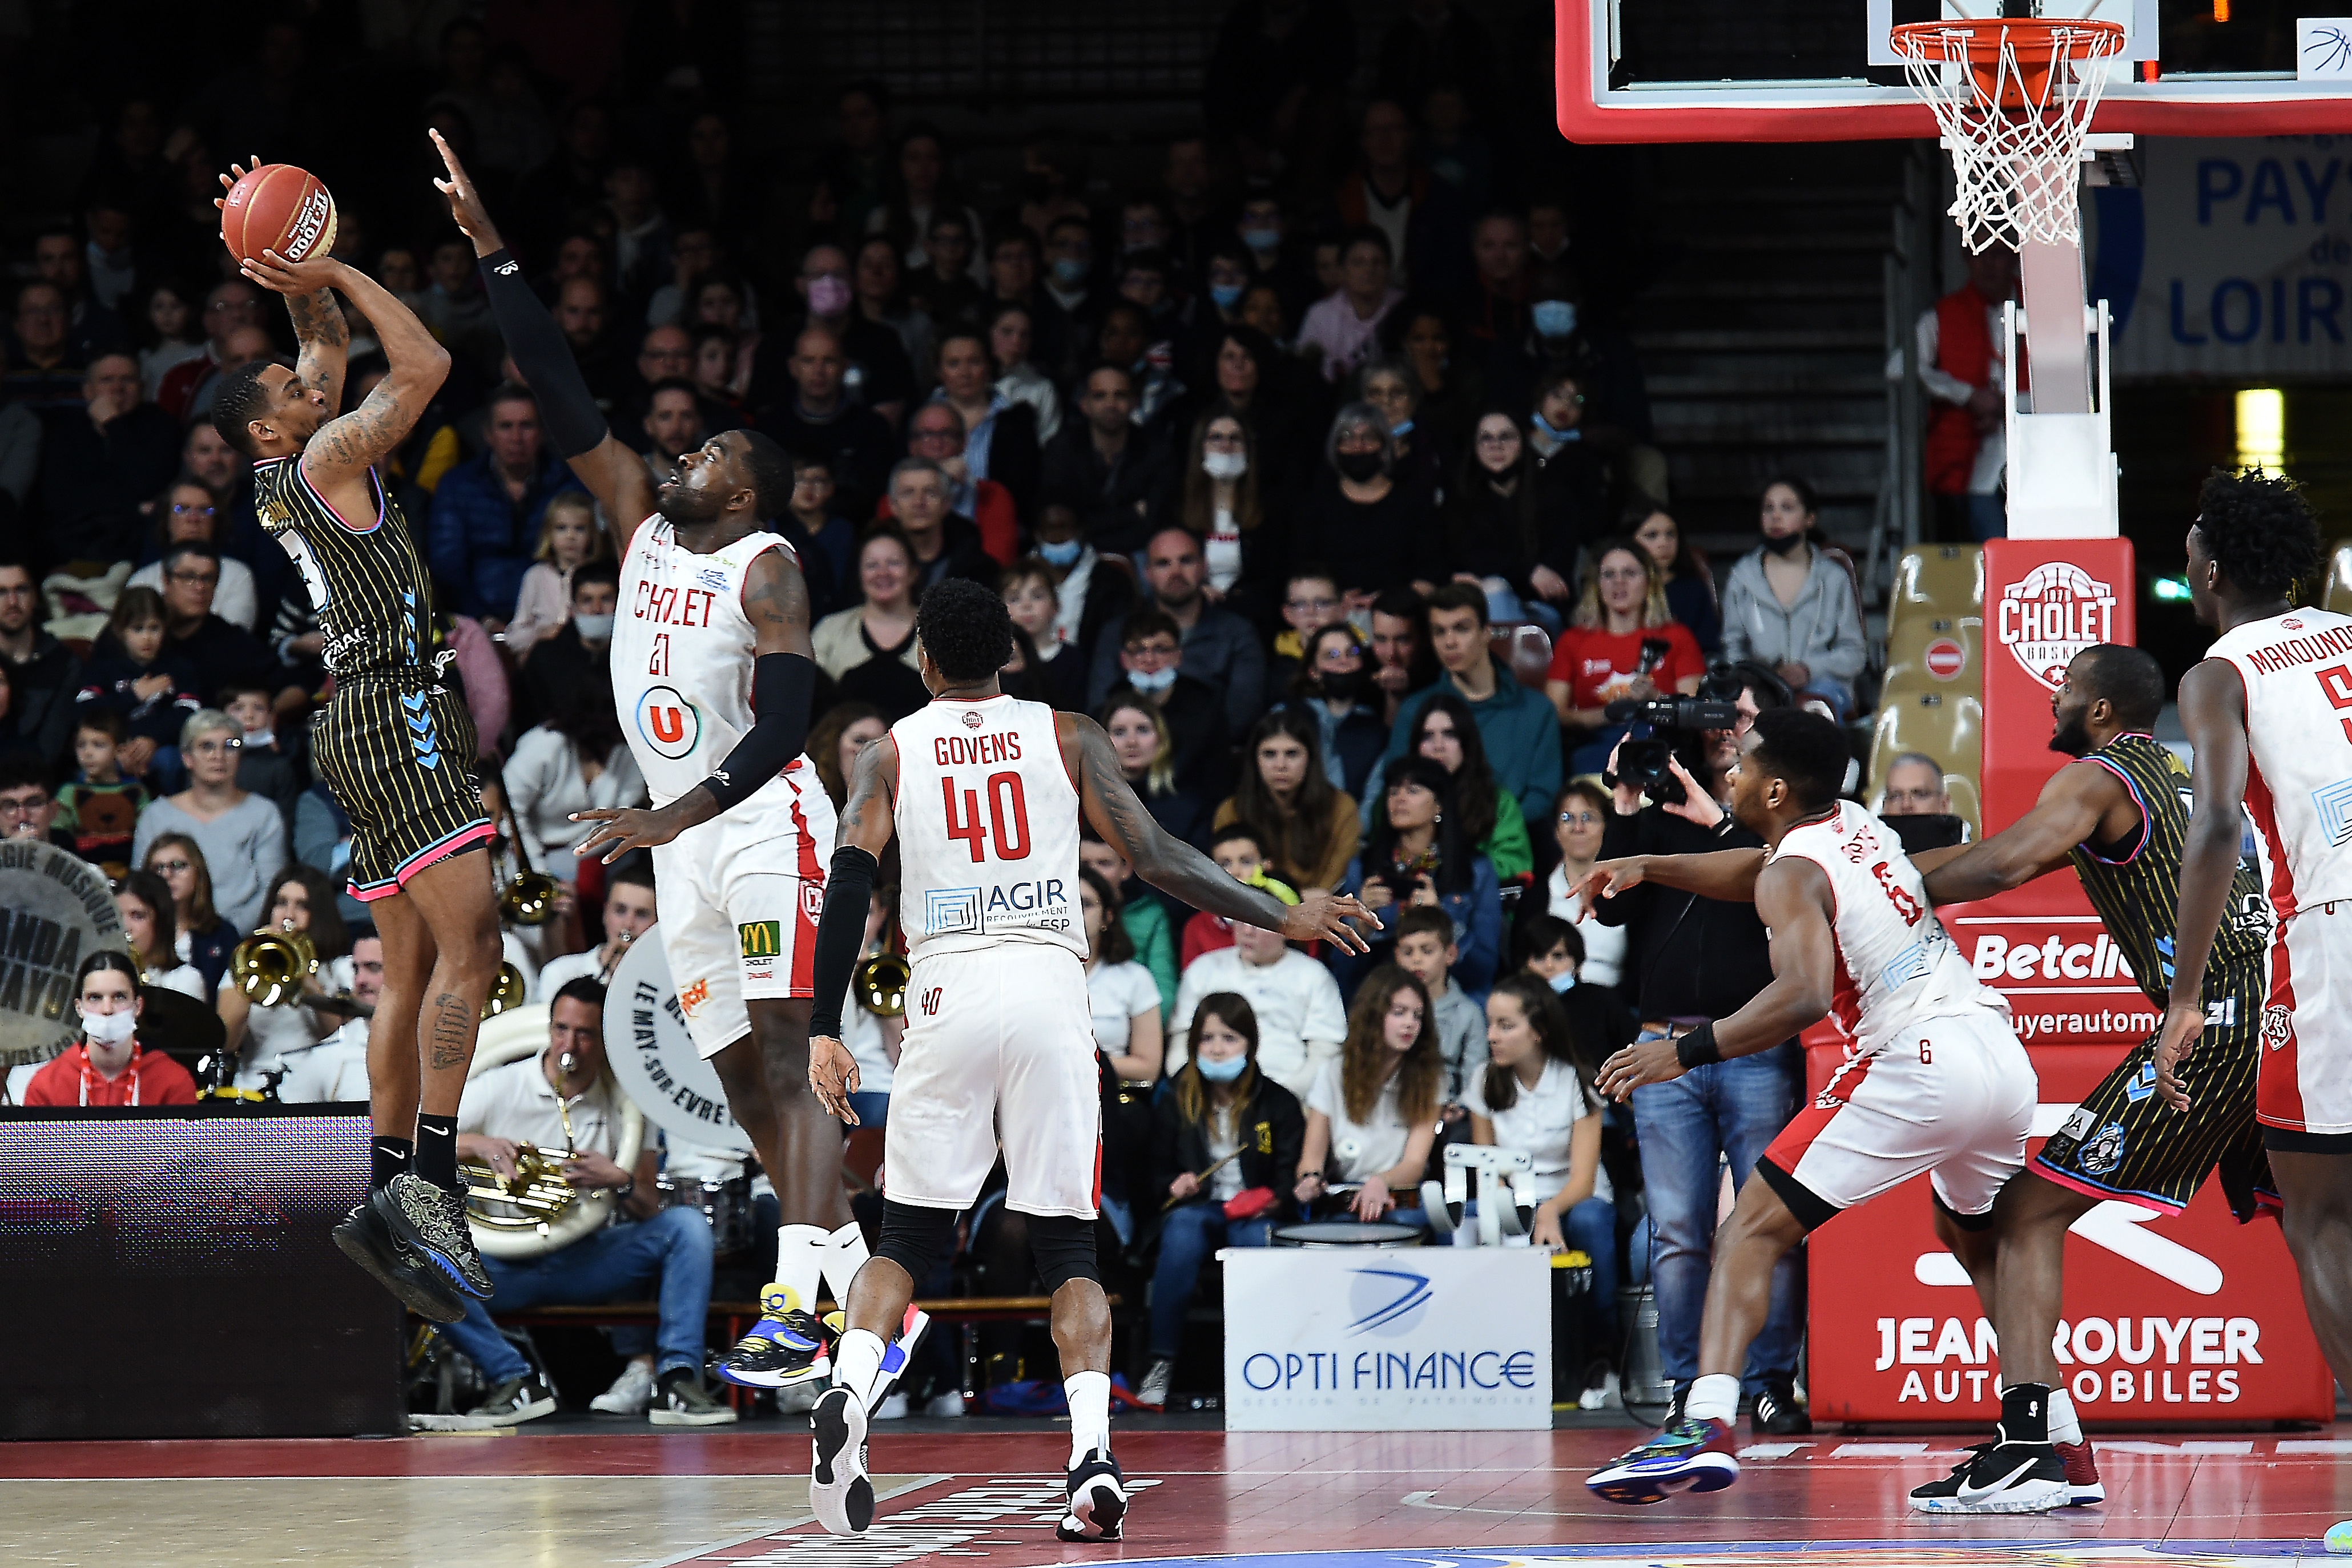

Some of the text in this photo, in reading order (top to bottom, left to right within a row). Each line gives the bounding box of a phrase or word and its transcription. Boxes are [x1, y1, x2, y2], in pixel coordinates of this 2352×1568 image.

[2198, 159, 2352, 224] PAY
[1999, 596, 2117, 644] CHOLET
[649, 633, 669, 676] 21
[2027, 646, 2078, 660] BASK
[2246, 625, 2352, 675] MAKOUND
[934, 732, 1021, 766] GOVENS
[941, 771, 1031, 863] 40
[987, 879, 1068, 912] AGIR
[635, 981, 658, 1005] LE
[921, 986, 943, 1016] 40
[1919, 1039, 1932, 1065] 6
[1243, 1352, 1338, 1390] OPTI
[1898, 1370, 2241, 1404] AUTOBILES
